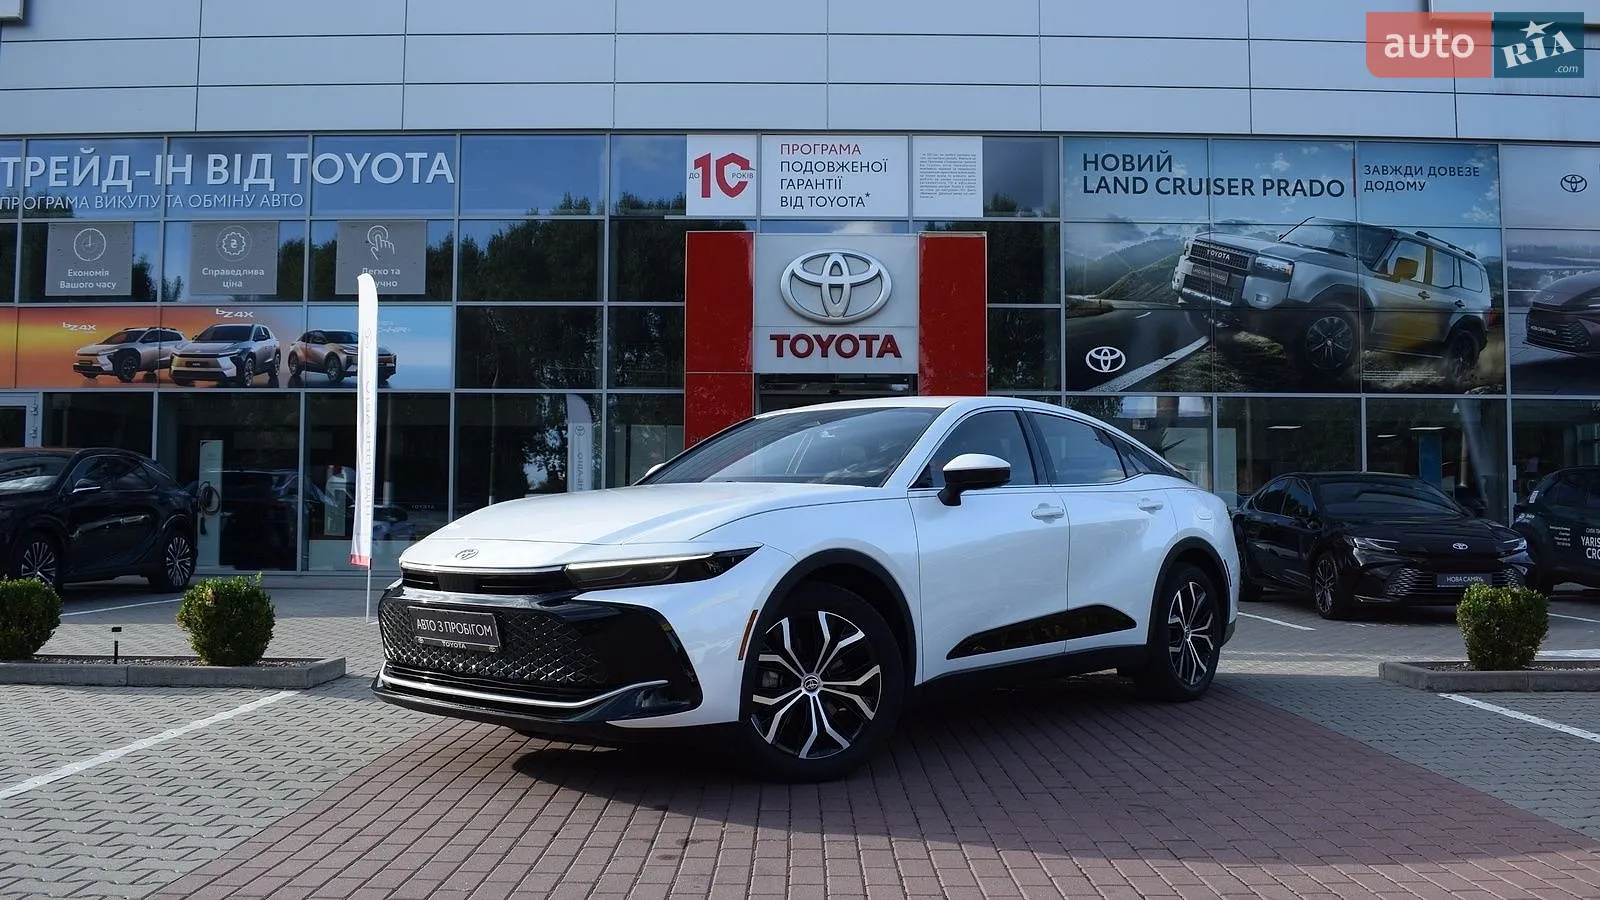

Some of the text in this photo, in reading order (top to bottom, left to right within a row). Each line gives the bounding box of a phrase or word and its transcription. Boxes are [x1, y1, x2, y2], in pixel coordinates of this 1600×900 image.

[780, 143, 862, 155] ПРОГРАМА
[780, 158, 888, 174] ПОДОВЖЕНОЇ
[1083, 149, 1173, 173] НОВИЙ
[0, 147, 455, 194] ТРЕЙД-ІН ВІД TOYOTA
[688, 172, 700, 180] ДО
[1363, 164, 1480, 178] ЗАВЖДИ ДОВЕЗЕ
[780, 175, 843, 190] ГАРАНТІЇ
[1083, 175, 1345, 198] LAND CRUISER PRADO
[1364, 180, 1426, 193] ДОДОМУ
[0, 193, 303, 210] ПРОГРАМА ВИКУПУ ТА ОБМІНУ АВТО
[780, 196, 804, 210] ВІД
[1206, 249, 1231, 261] TOYOTA
[67, 268, 109, 277] Економія
[201, 267, 265, 278] Справедлива
[391, 268, 401, 276] та
[60, 280, 117, 290] Вашого часу
[222, 280, 243, 289] ціна
[769, 333, 903, 359] TOYOTA
[416, 619, 493, 637] АВТО З ПРОБІГОМ
[441, 640, 467, 649] TOYOTA
